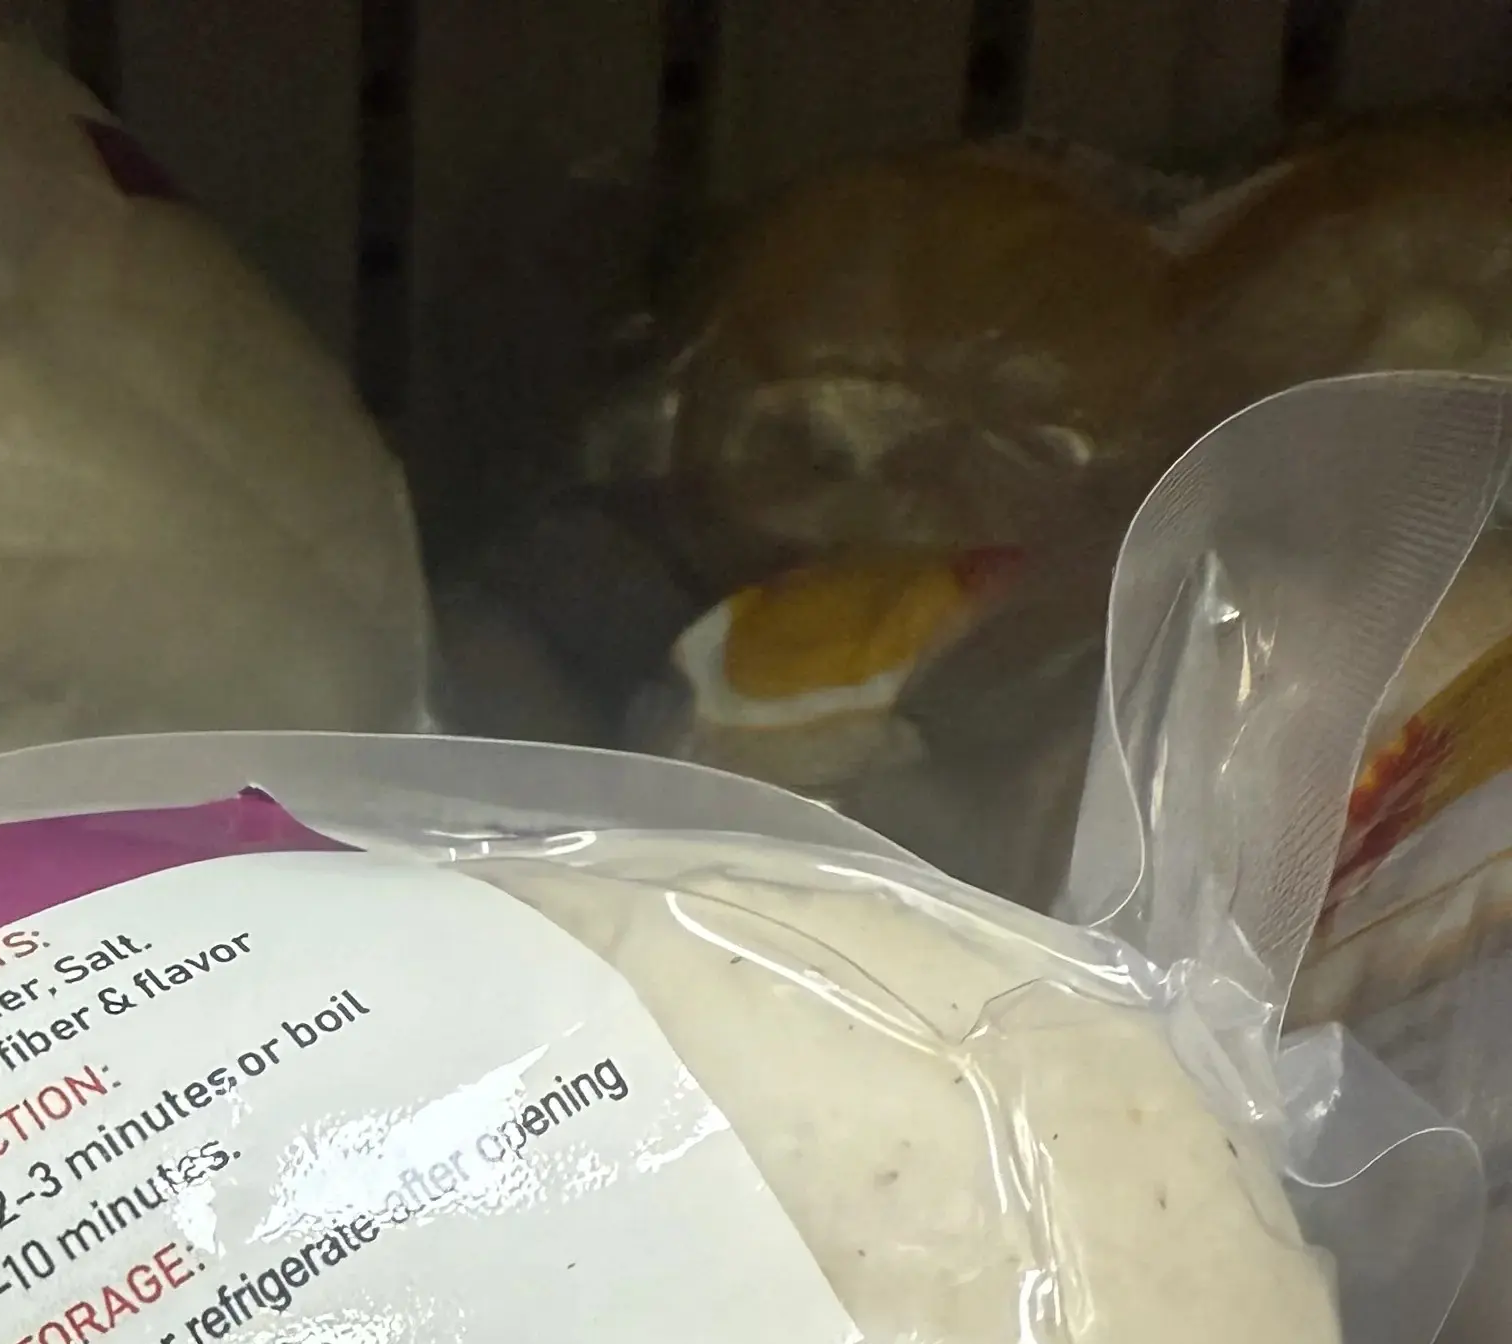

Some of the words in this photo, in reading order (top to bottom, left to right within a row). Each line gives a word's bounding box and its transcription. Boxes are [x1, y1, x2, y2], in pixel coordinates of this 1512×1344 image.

[54, 935, 152, 983] Salt.
[97, 987, 137, 1015] &
[133, 933, 249, 998] flavor
[65, 1067, 237, 1180] minutes
[237, 1038, 280, 1076] or
[281, 989, 370, 1048] boil
[385, 1150, 469, 1223] after
[476, 1058, 629, 1163] opening
[57, 1140, 241, 1261] minutes.
